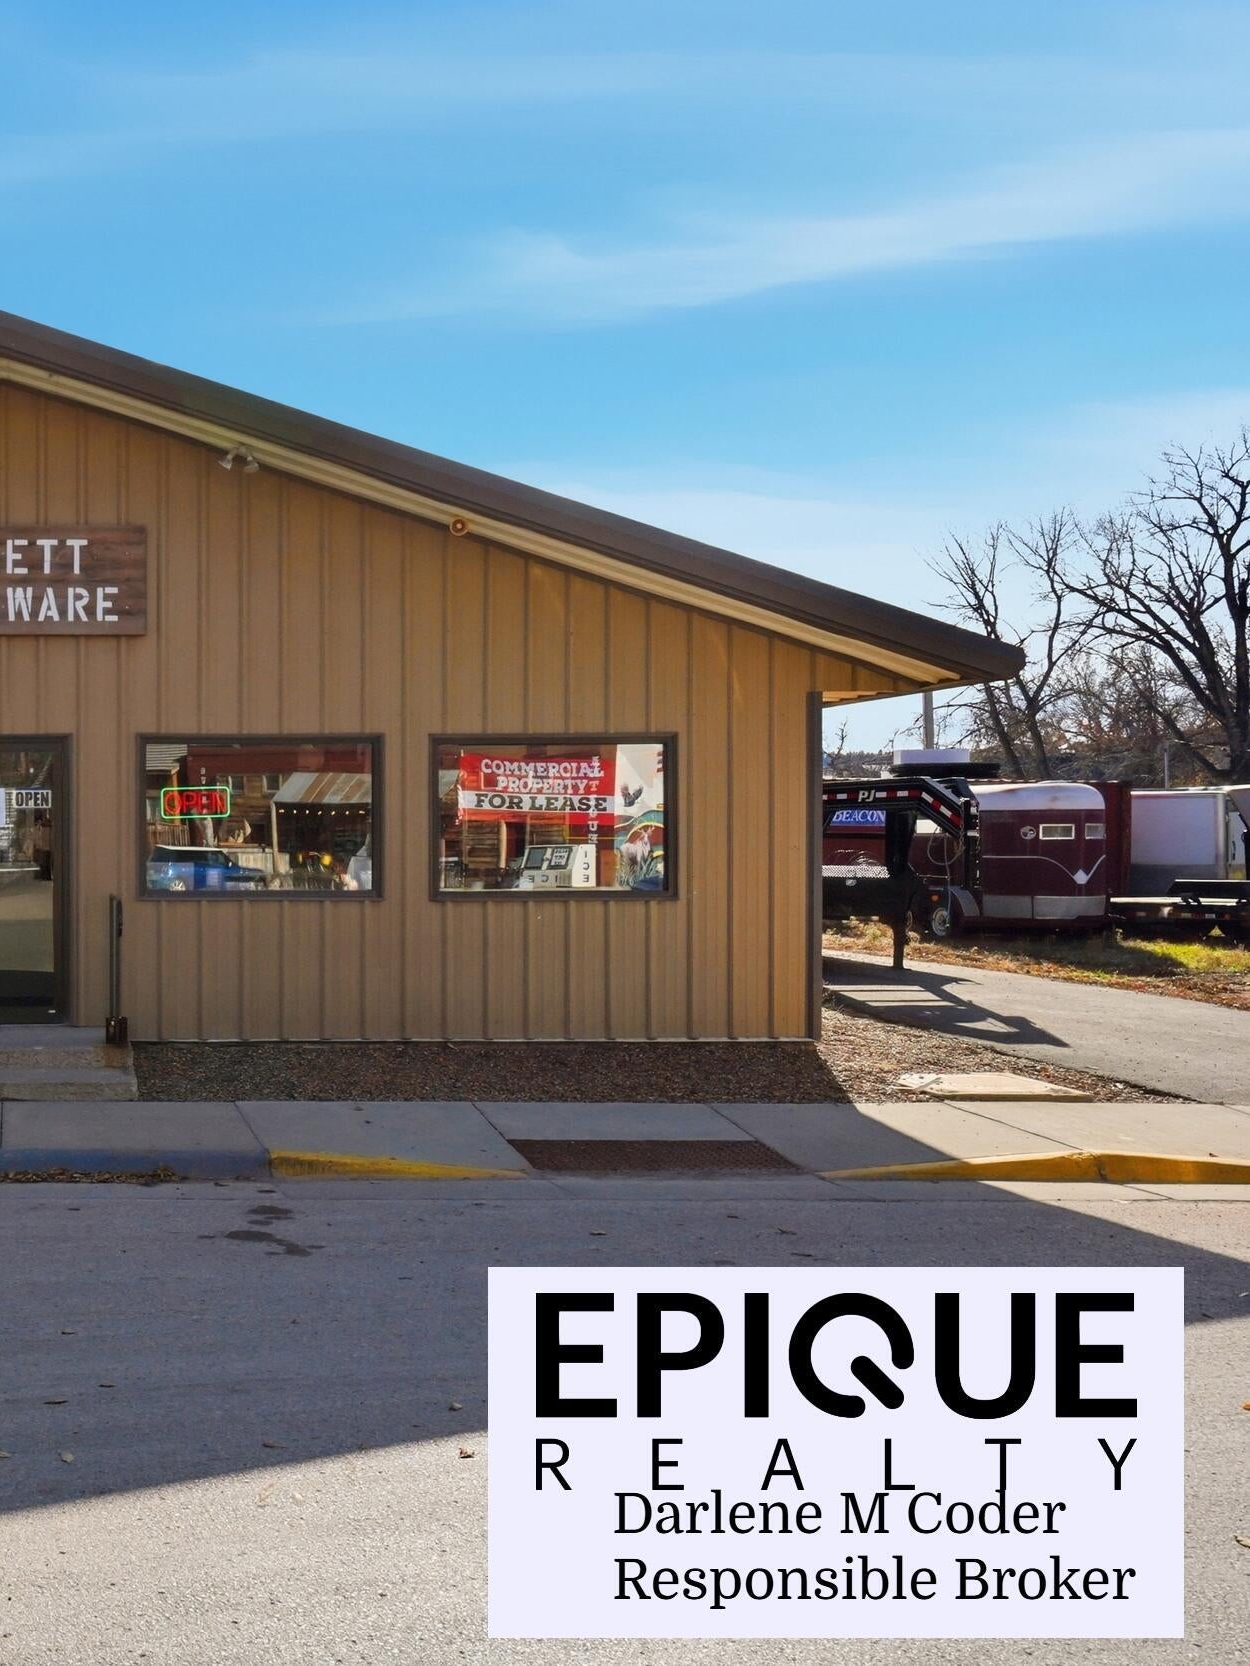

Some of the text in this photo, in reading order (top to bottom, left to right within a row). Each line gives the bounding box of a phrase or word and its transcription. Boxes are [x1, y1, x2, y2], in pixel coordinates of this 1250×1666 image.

[480, 758, 605, 778] COMMERCIAL
[496, 776, 587, 794] PROPERTY
[15, 791, 51, 807] OPEN
[165, 791, 227, 815] OPEN
[475, 793, 608, 812] FOR LEASE
[857, 789, 876, 802] PJ
[832, 809, 887, 822] BEACON
